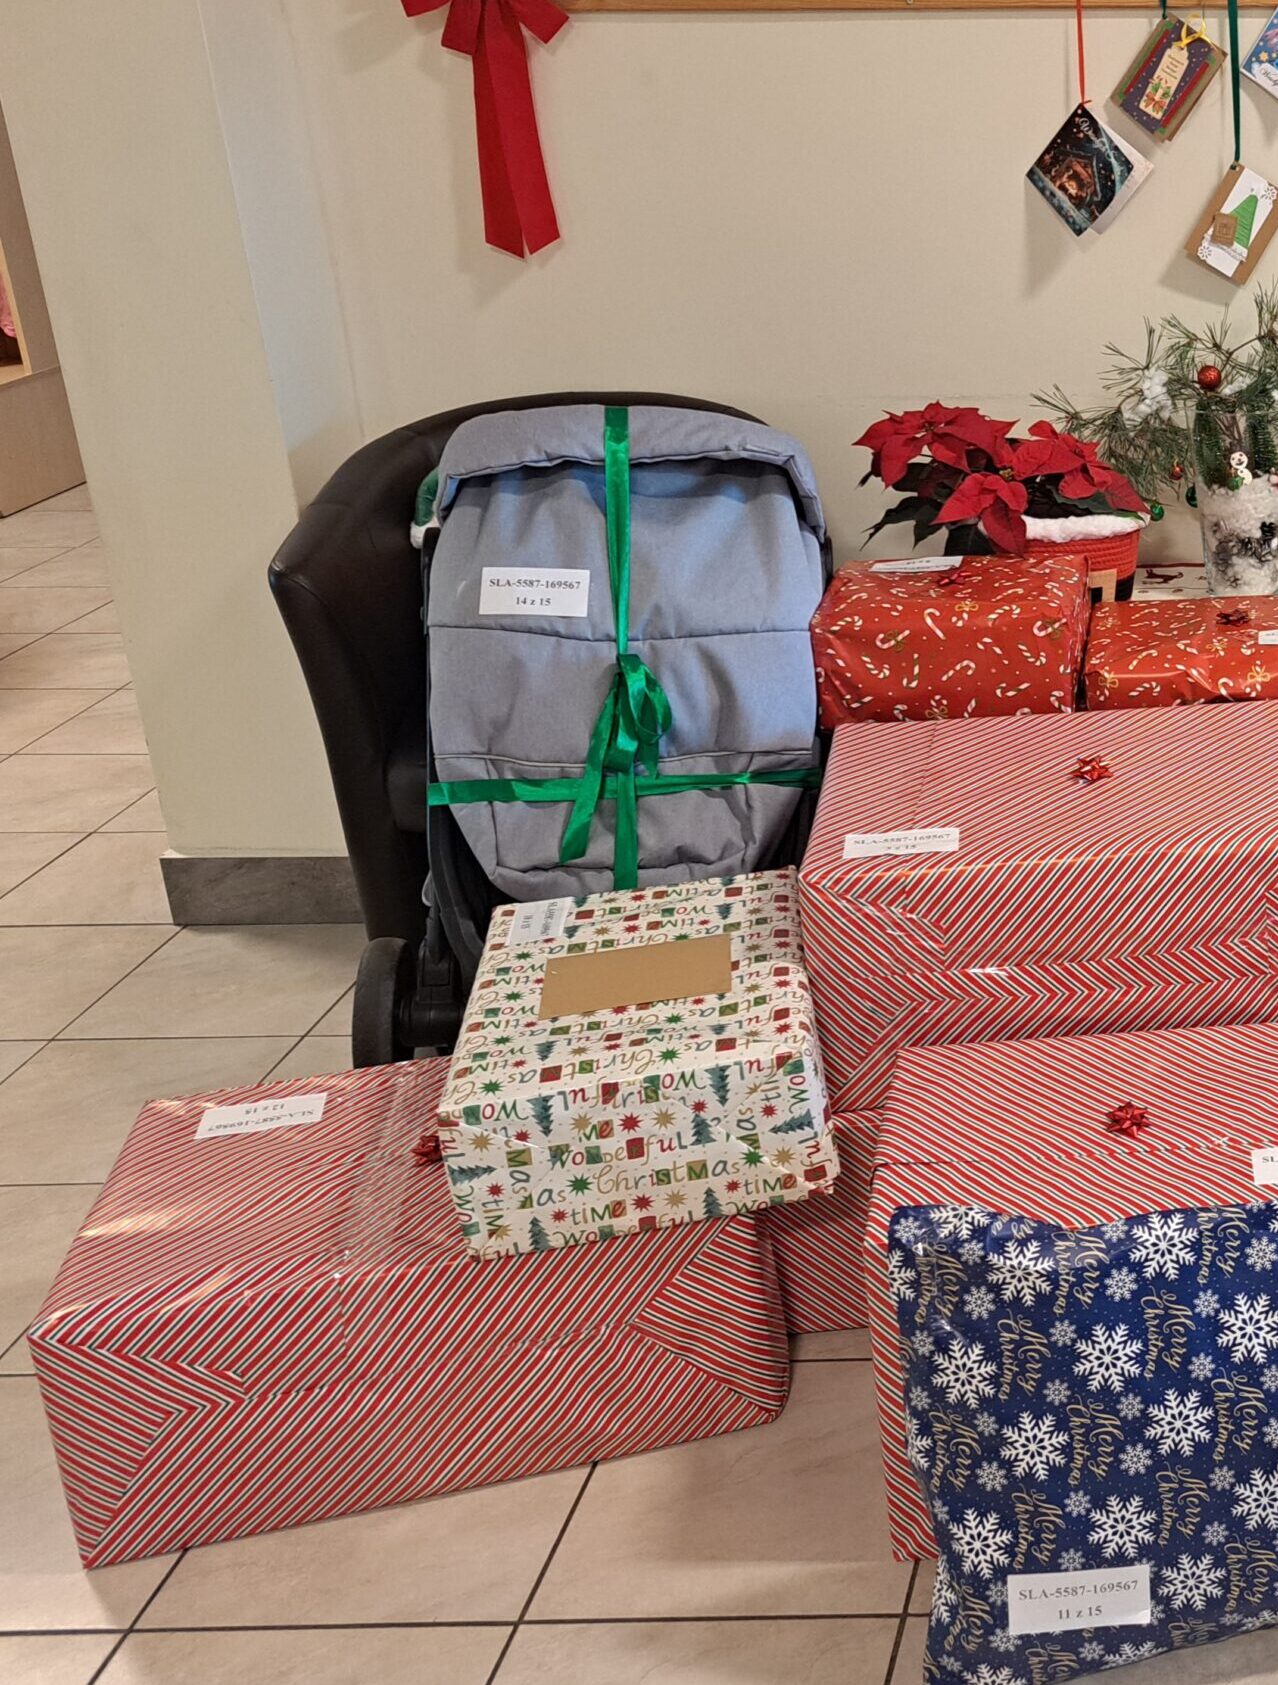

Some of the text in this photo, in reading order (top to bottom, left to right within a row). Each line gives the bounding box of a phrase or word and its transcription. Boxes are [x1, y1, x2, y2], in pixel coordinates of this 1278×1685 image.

[488, 578, 582, 590] SLA-5587-169567
[515, 597, 527, 605] 14
[539, 597, 552, 606] 15
[207, 1110, 315, 1132] SLA-5587-169567
[997, 1309, 1020, 1403] Christmas
[1016, 1315, 1051, 1397] Merry
[1140, 1286, 1165, 1381] Christmas
[1160, 1289, 1196, 1374] Merry
[1066, 1395, 1091, 1487] Christmas
[1088, 1399, 1124, 1481] Merry
[1211, 1366, 1234, 1463] Christmas
[1232, 1370, 1267, 1454] Merry
[1012, 1483, 1034, 1572] Christmas
[1030, 1489, 1066, 1567] Merry
[1156, 1461, 1178, 1549] Christmas
[1176, 1464, 1210, 1540] Merry
[1018, 1580, 1138, 1601] SLA-5587-169567
[1058, 1605, 1102, 1620] 11 z 15
